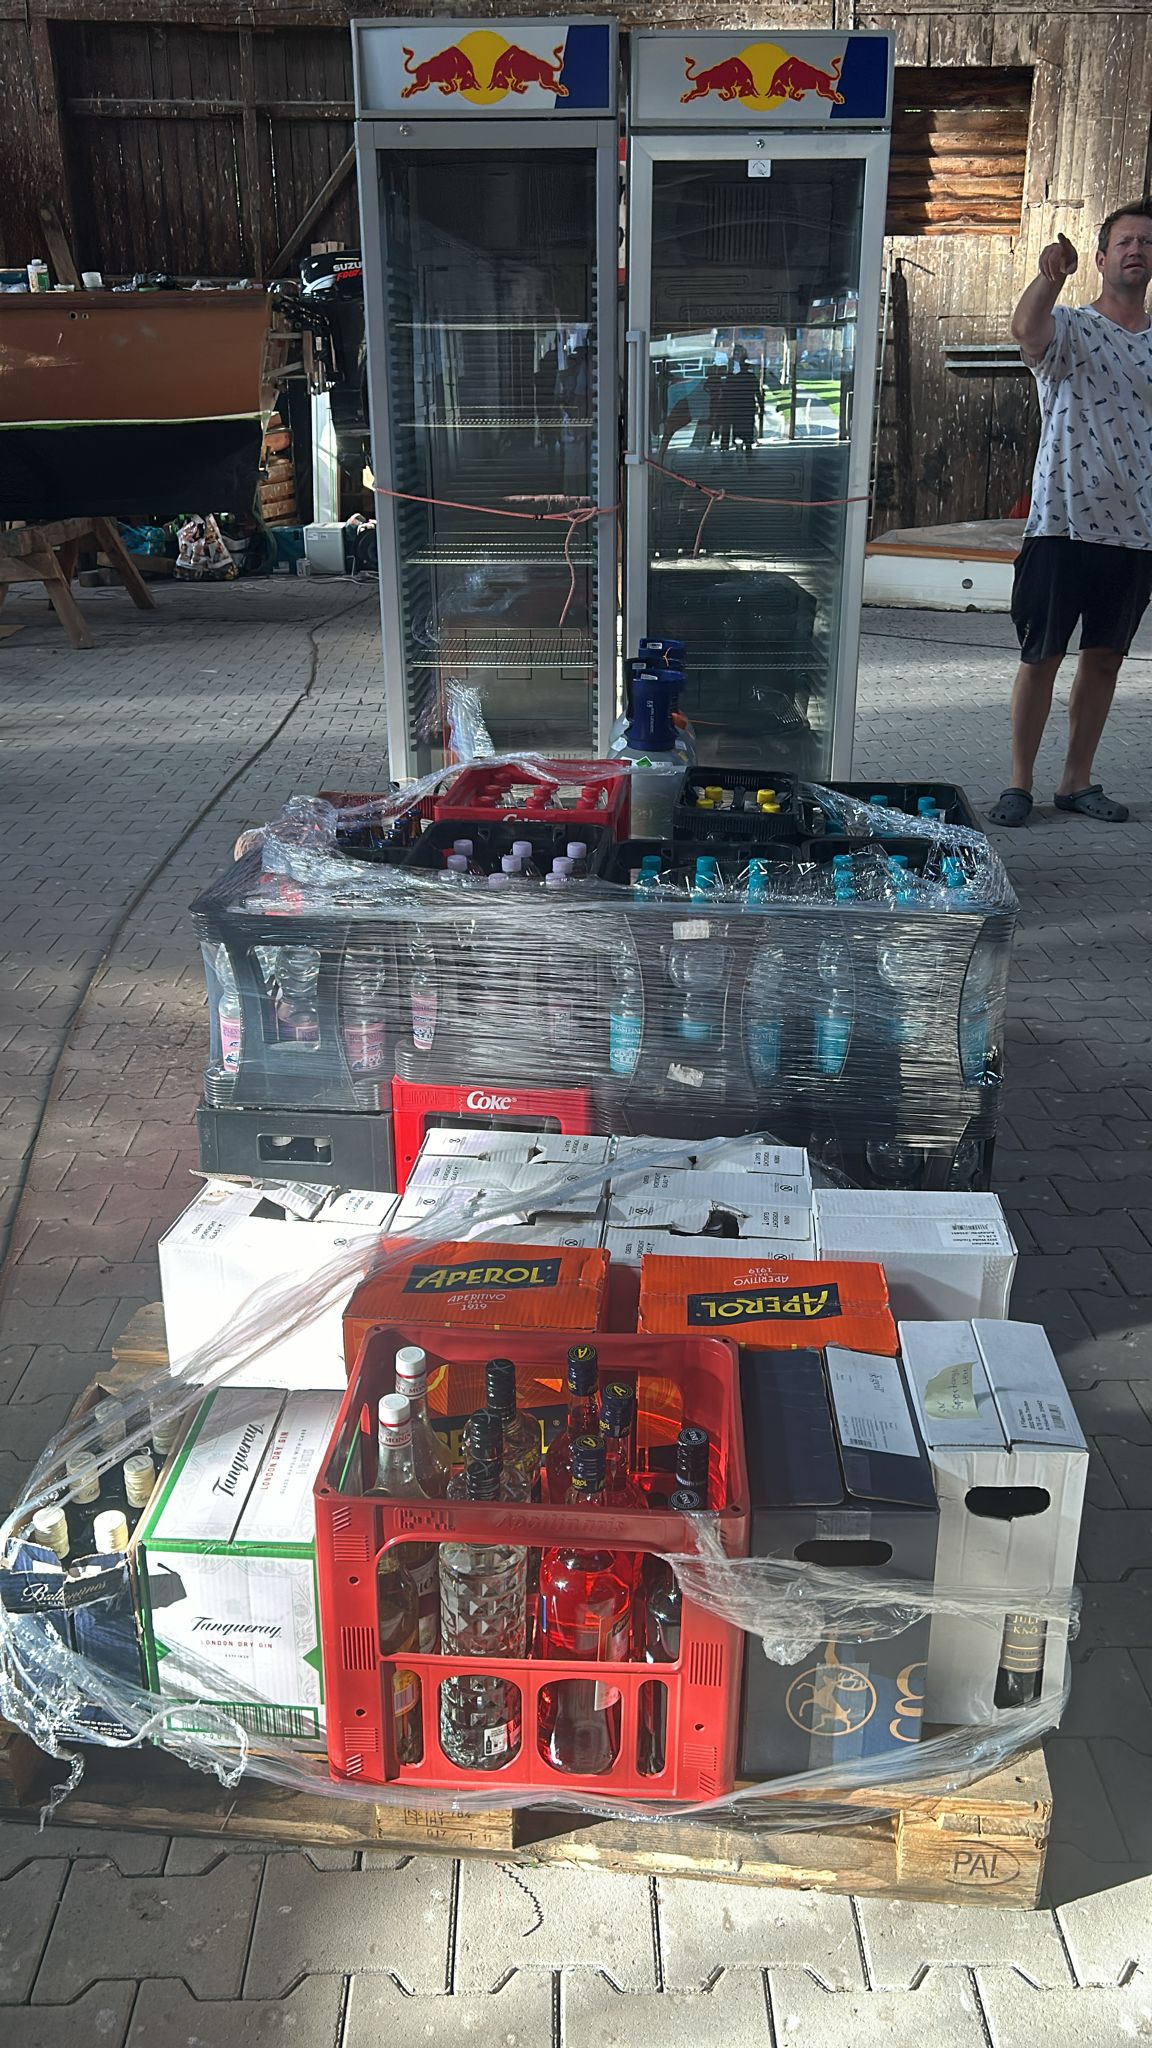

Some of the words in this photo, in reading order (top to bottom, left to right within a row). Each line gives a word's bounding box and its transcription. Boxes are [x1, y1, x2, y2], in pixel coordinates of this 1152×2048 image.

[333, 261, 361, 272] SUZU
[466, 1090, 512, 1110] Coke
[415, 1266, 545, 1289] APEROL
[733, 1276, 790, 1286] APERITIVO
[447, 1293, 506, 1303] APERITIVO
[460, 1303, 488, 1311] 1919
[701, 1290, 829, 1318] APEROL
[212, 1423, 265, 1497] Tanqueray
[260, 1463, 277, 1490] LONDON
[271, 1446, 284, 1460] DRY
[190, 1616, 282, 1639] Tanqueray
